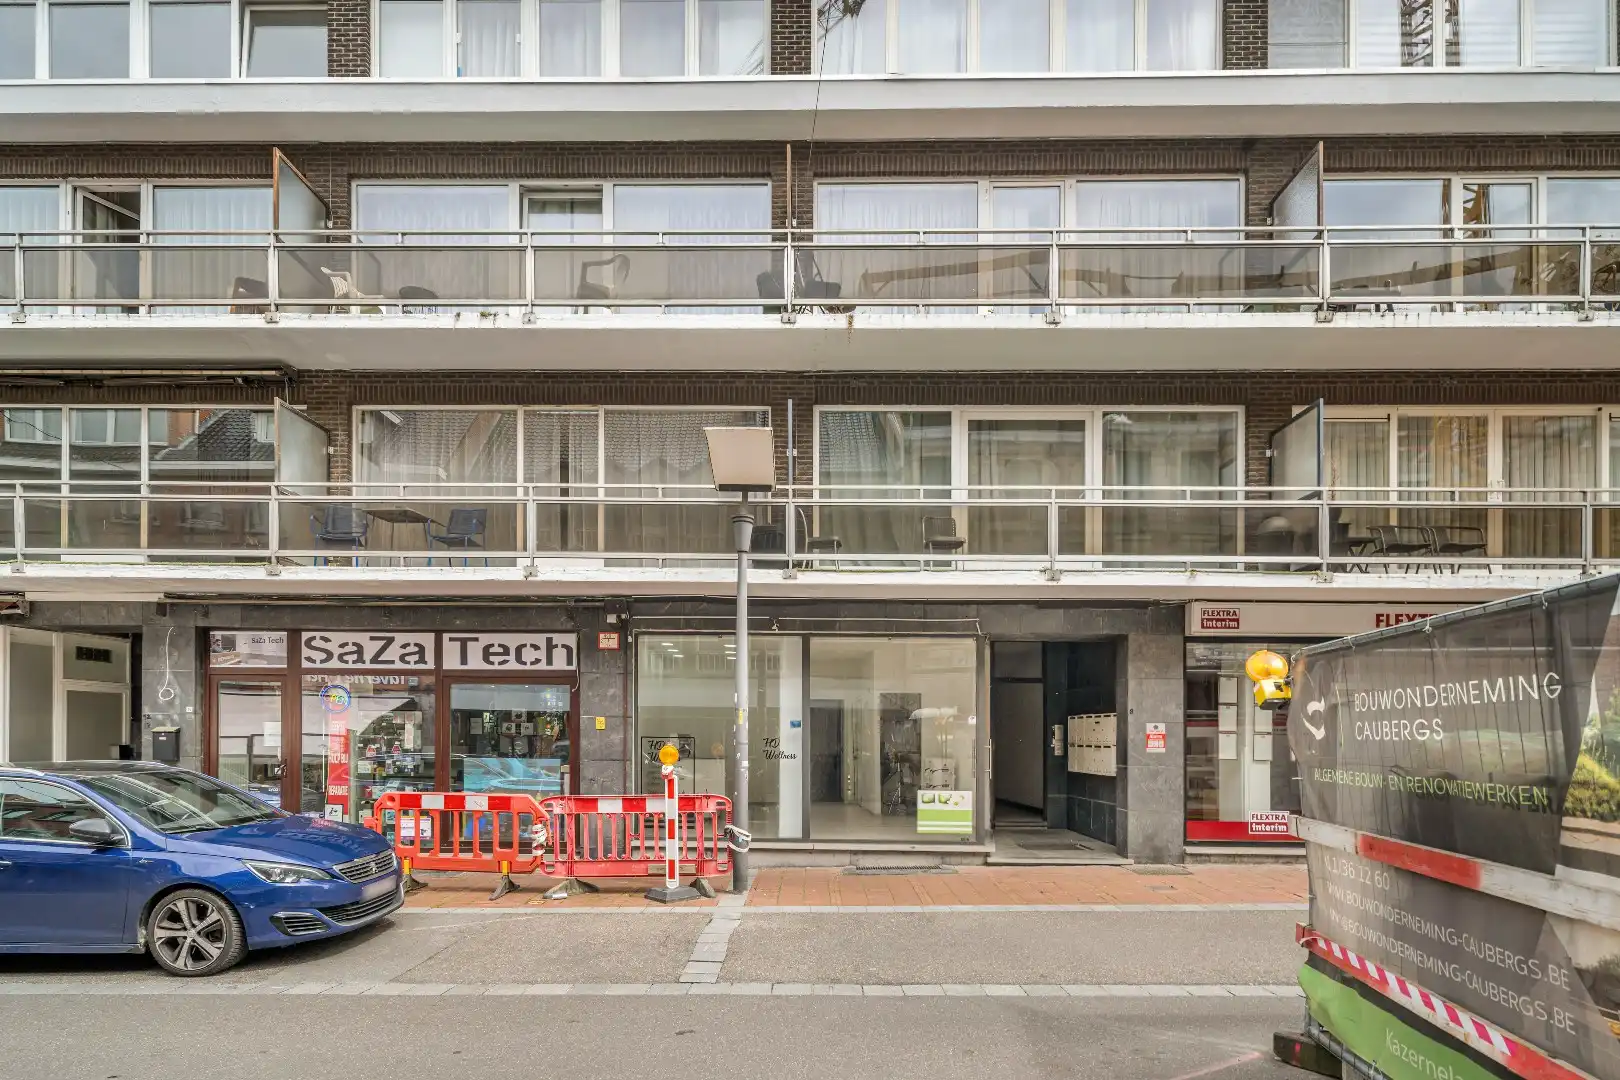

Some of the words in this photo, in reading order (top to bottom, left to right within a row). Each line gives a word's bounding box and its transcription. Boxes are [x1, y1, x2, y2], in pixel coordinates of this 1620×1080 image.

[1202, 609, 1238, 618] FLEXTRA
[1202, 618, 1238, 628] interim
[1375, 613, 1439, 628] FLEX
[267, 636, 284, 644] Tech
[303, 635, 428, 665] SaZa
[448, 636, 574, 666] Tech
[1354, 671, 1562, 712] BOUWONDERNEMING
[1355, 718, 1443, 741] CAUBERGS
[763, 737, 780, 748] HD
[763, 749, 798, 760] Wellness
[1314, 767, 1354, 786] ALGEMENE
[1388, 775, 1404, 792] EN
[1406, 776, 1549, 806] RENOVATIEWERKEN
[1251, 813, 1287, 821] FLEXTRA
[1251, 822, 1287, 832] interim
[1358, 865, 1372, 884] 12
[1374, 869, 1390, 891] 60
[1386, 1028, 1465, 1080] Kazernel
